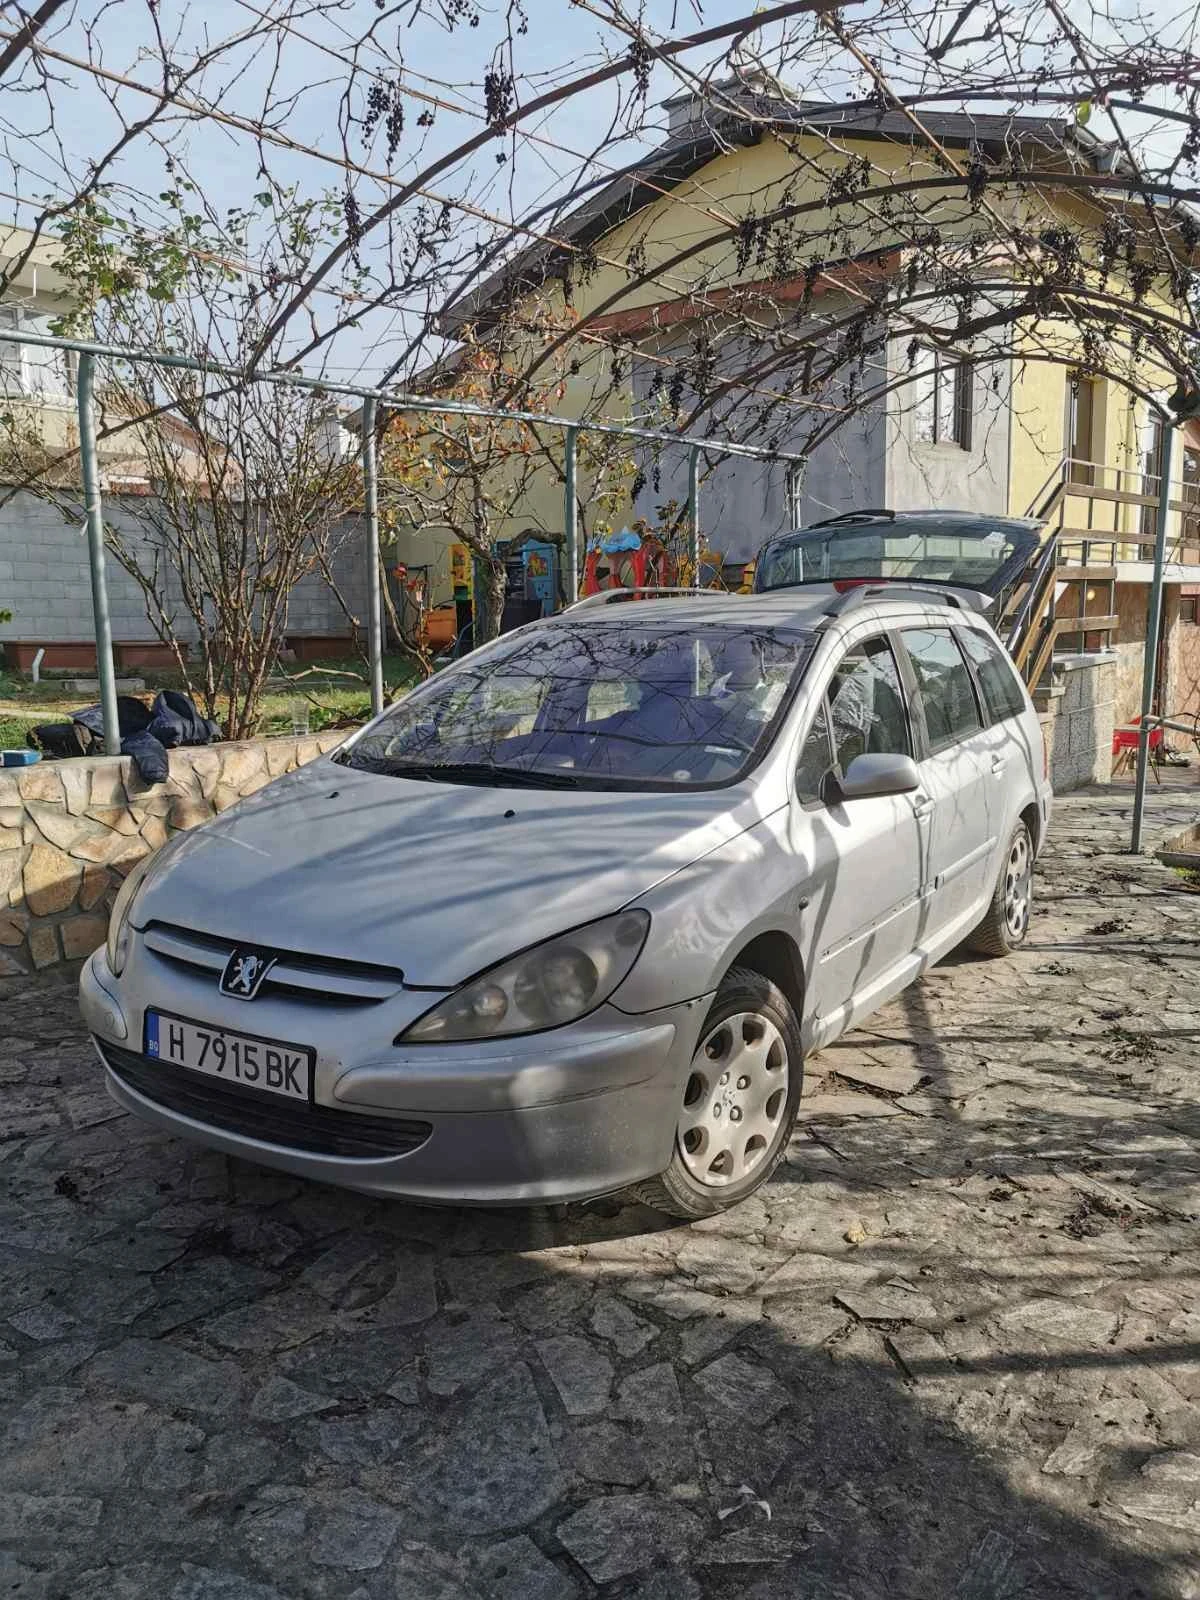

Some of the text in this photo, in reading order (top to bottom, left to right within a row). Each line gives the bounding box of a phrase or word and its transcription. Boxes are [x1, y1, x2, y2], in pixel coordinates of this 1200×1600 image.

[170, 1024, 302, 1094] H 7915 BK
